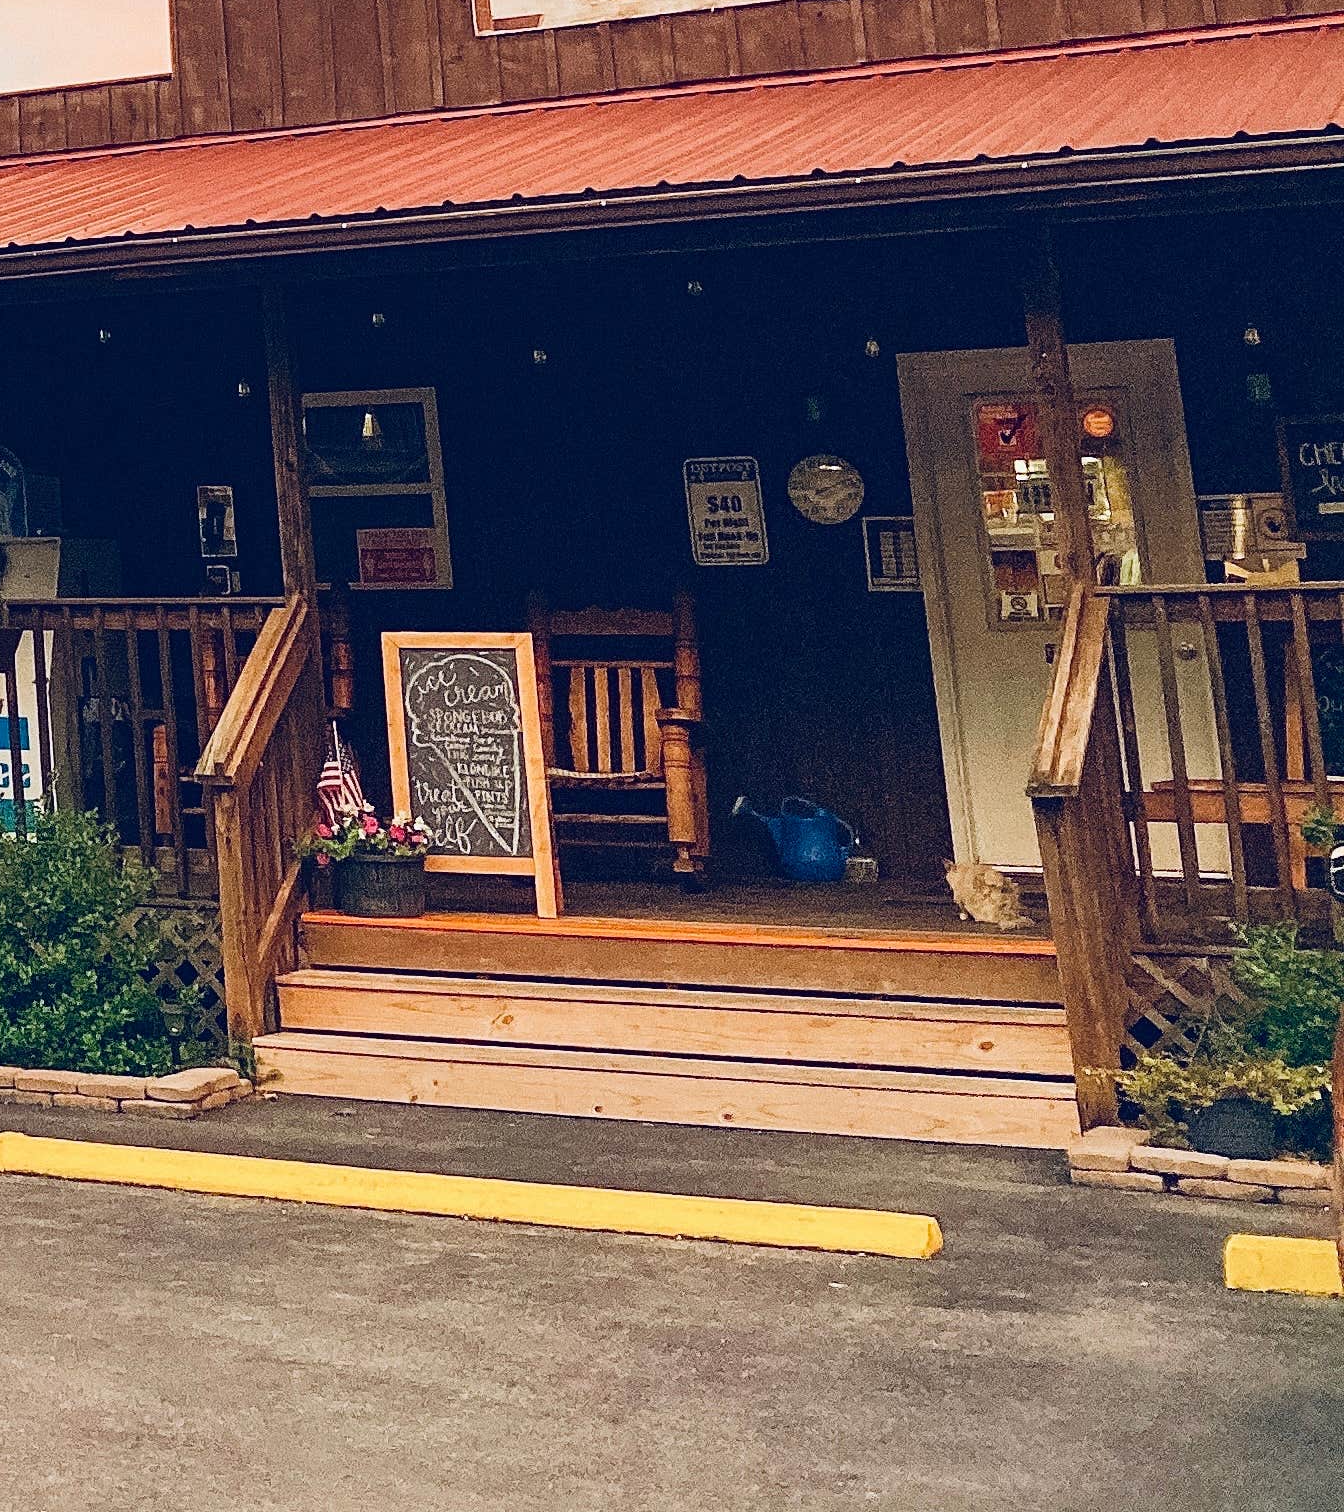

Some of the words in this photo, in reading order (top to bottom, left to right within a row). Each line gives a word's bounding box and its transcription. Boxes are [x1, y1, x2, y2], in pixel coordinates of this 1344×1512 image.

[1299, 442, 1344, 466] CHE
[444, 682, 511, 707] cream
[430, 815, 479, 854] elf
